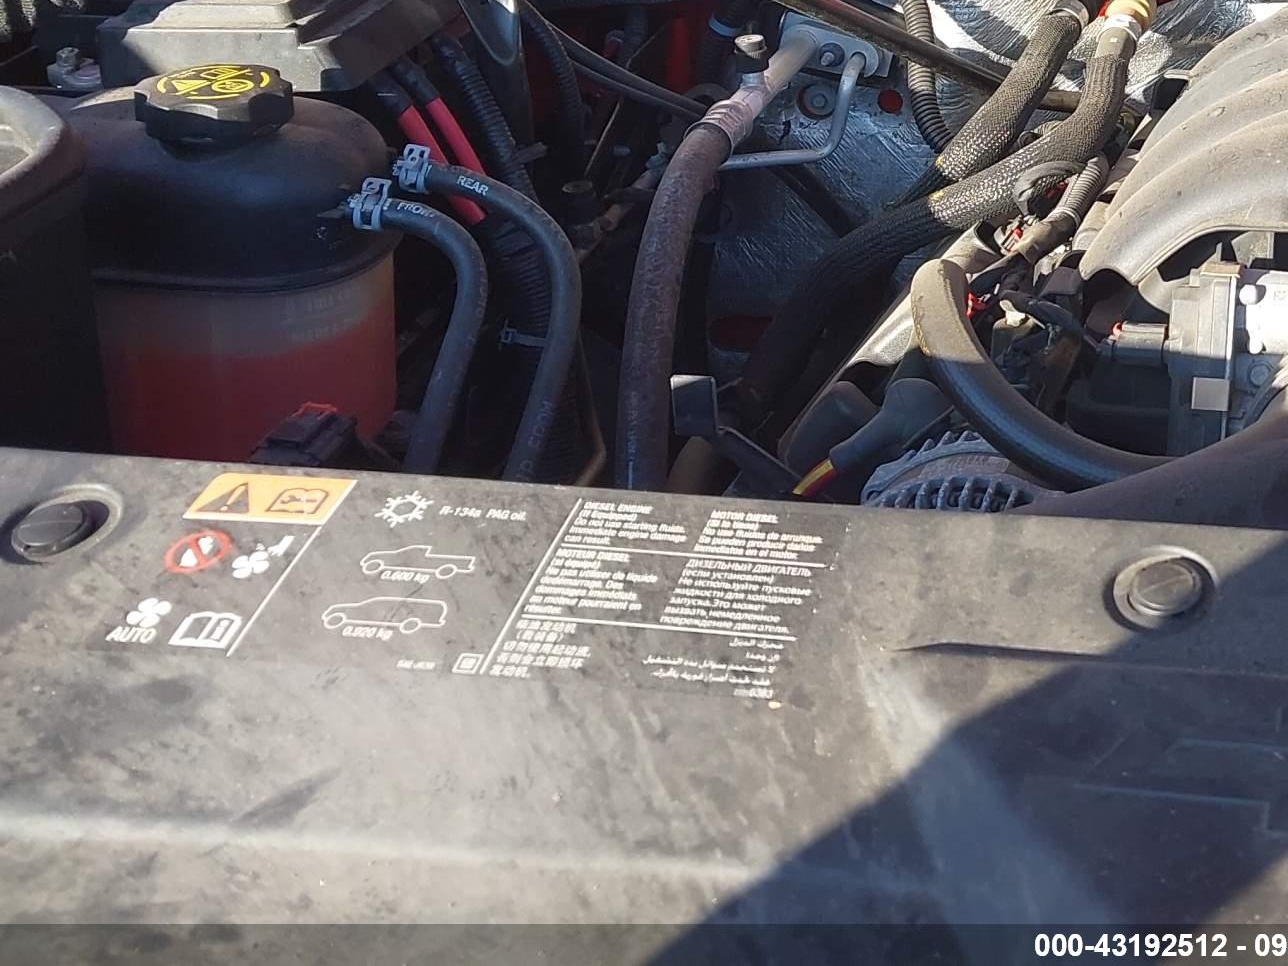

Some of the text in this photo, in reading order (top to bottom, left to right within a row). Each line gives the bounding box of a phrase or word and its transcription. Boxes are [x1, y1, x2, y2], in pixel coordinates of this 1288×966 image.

[457, 175, 489, 196] REAR
[439, 505, 481, 518] R-134a
[486, 510, 510, 521] PAG
[584, 501, 616, 511] DIESEL
[555, 547, 630, 562] MOTEUR DIESEL
[413, 572, 430, 584] kg
[752, 565, 812, 577] ДВИГАТЕЛЬ
[105, 626, 158, 644] AUTO
[376, 628, 394, 641] kg
